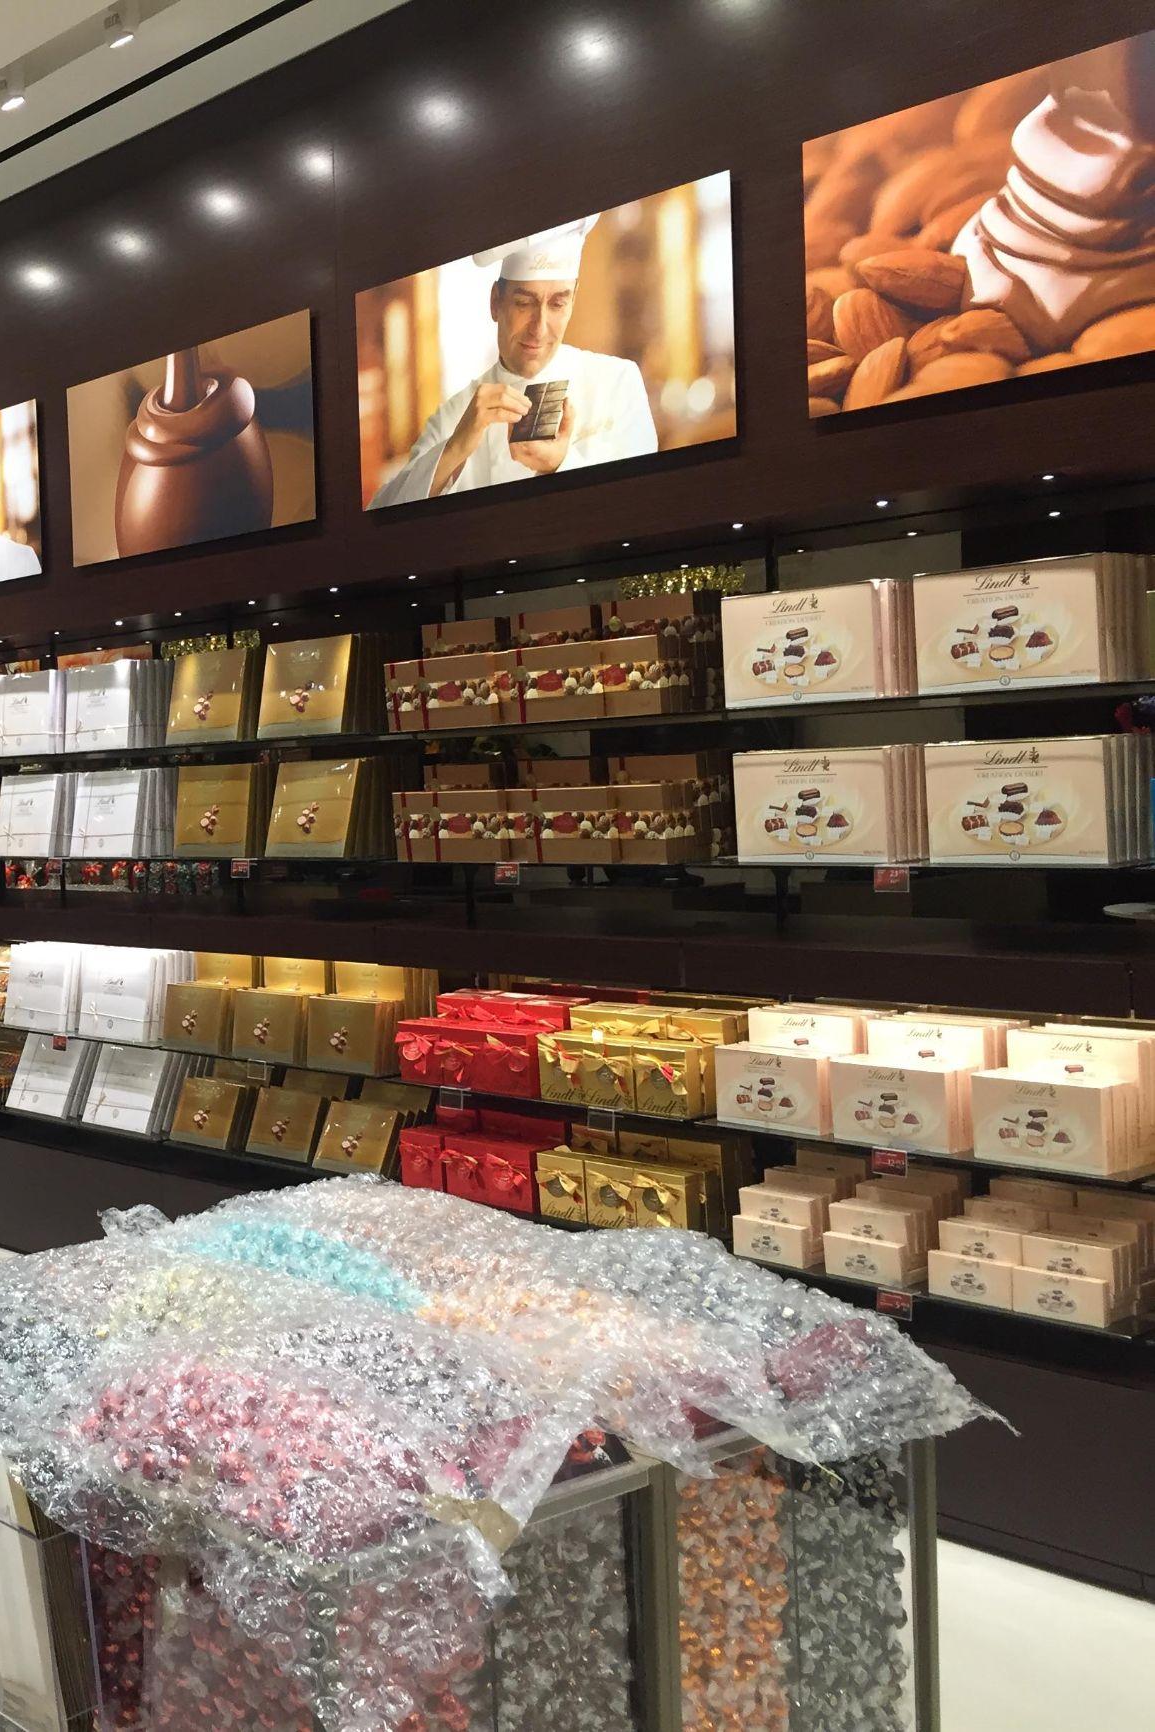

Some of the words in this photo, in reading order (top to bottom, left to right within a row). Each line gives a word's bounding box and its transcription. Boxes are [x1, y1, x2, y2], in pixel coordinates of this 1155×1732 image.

[972, 572, 1019, 591] Lindt
[772, 597, 808, 613] Lindt
[983, 750, 1028, 766] Lindt
[782, 758, 821, 773] Lindt
[782, 1016, 808, 1027] Lindt
[906, 1028, 935, 1039] Lindt
[1052, 1041, 1083, 1053] Lindt
[868, 1069, 897, 1082] Lindt
